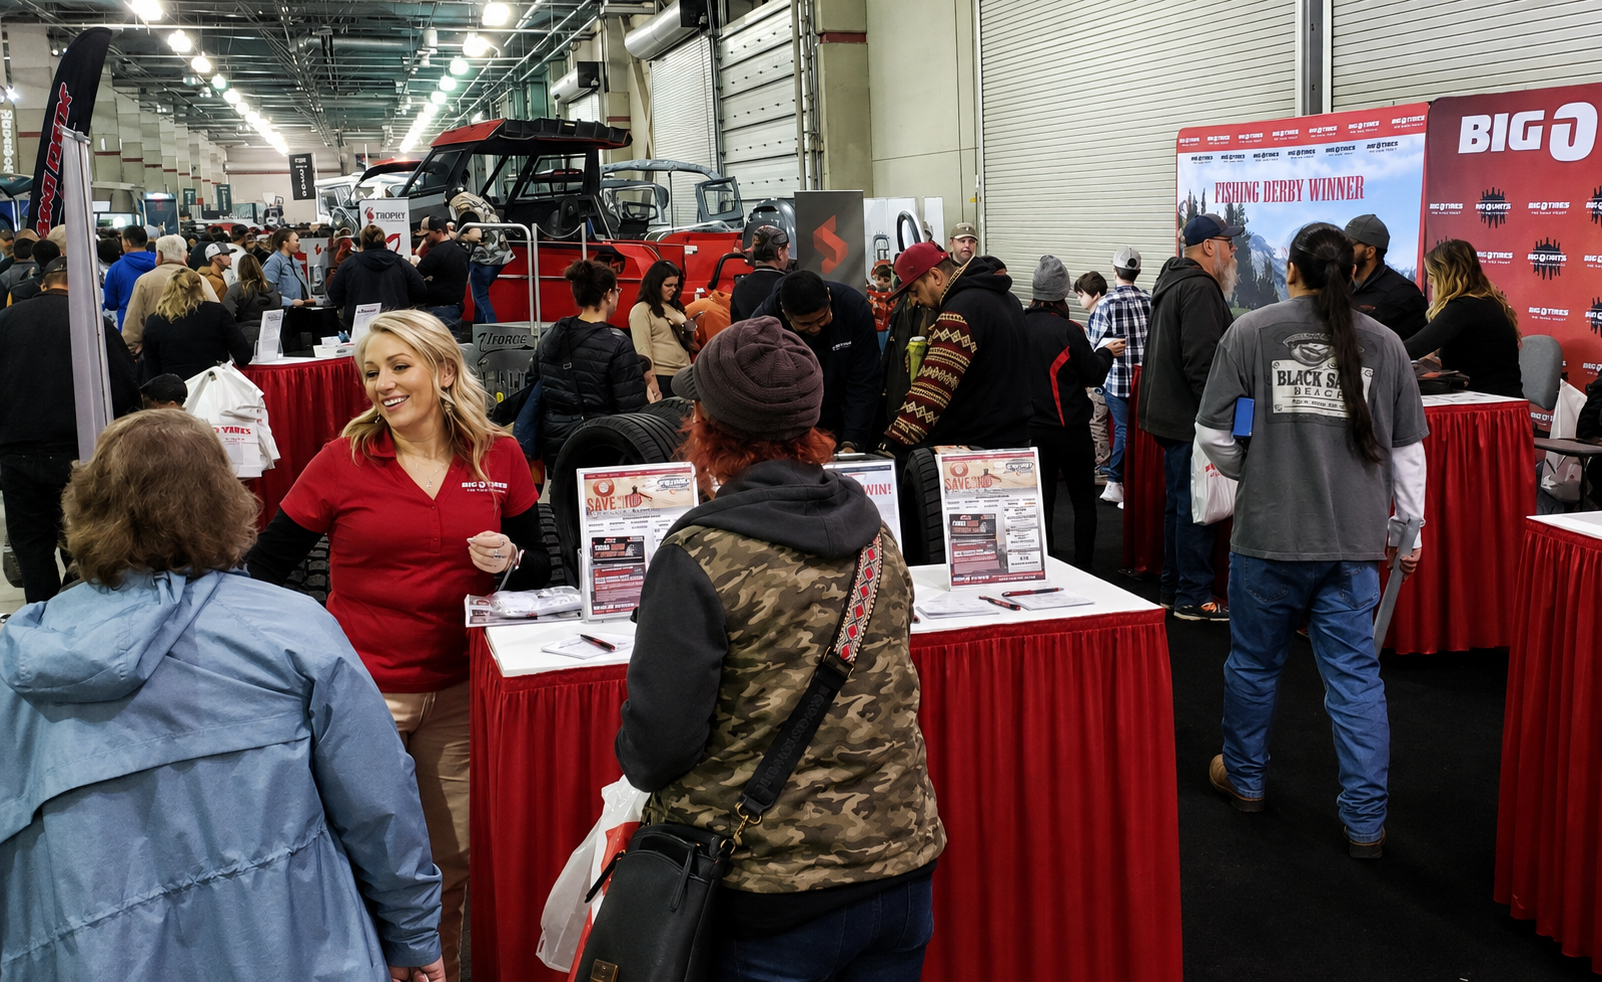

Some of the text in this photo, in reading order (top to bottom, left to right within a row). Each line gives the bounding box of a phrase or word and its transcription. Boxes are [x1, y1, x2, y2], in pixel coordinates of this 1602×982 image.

[1458, 102, 1598, 162] BIG O
[1215, 175, 1365, 204] FISHING DERBY WINNER
[375, 211, 406, 220] TROPHY
[1277, 370, 1342, 389] BLACK SA
[861, 483, 892, 496] WIN!
[945, 476, 971, 491] SAVE
[586, 495, 616, 513] SAVE
